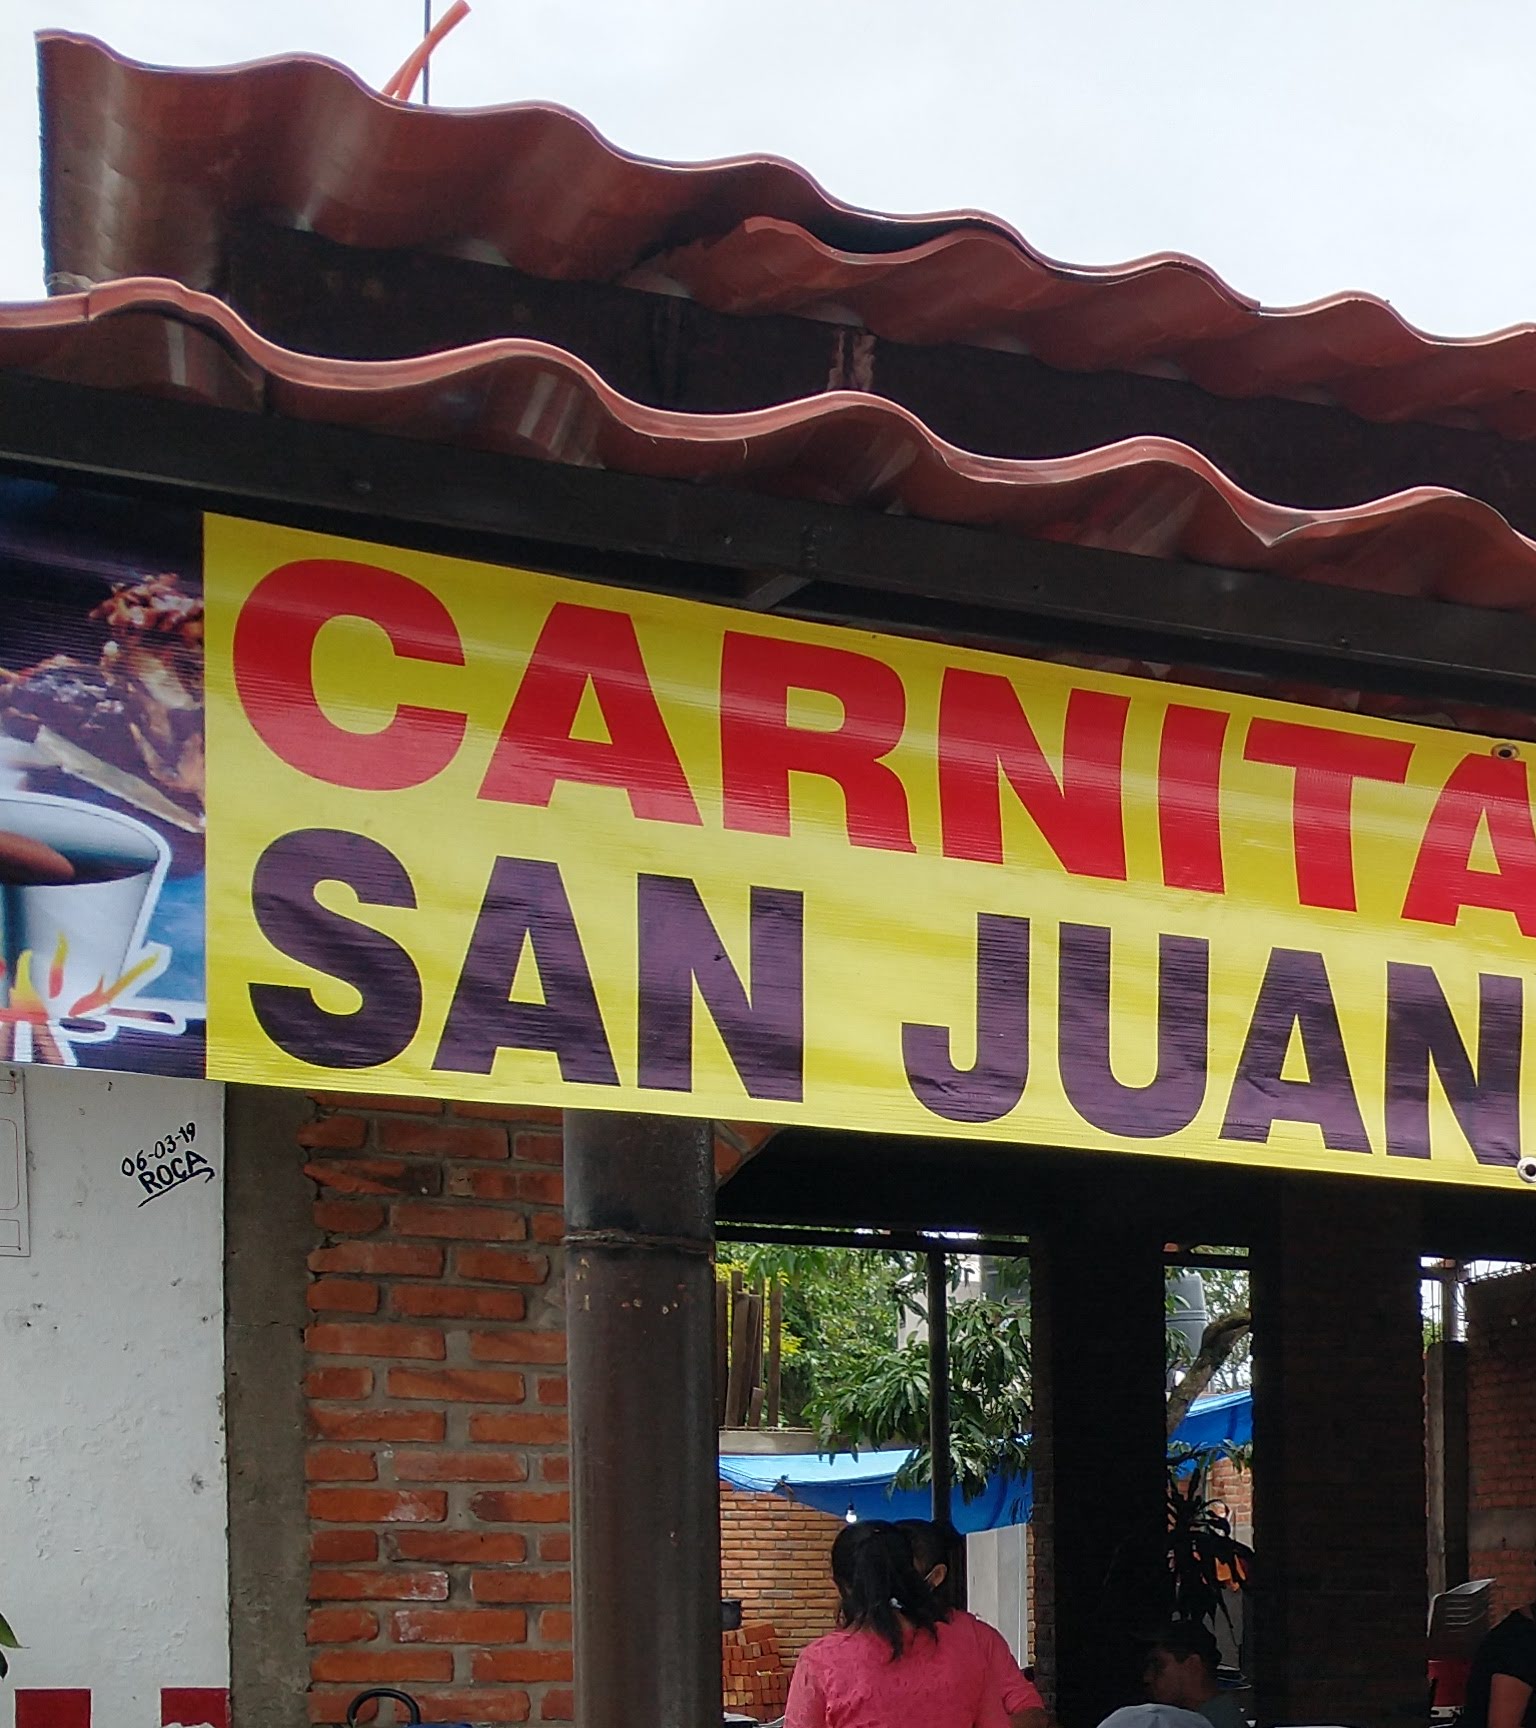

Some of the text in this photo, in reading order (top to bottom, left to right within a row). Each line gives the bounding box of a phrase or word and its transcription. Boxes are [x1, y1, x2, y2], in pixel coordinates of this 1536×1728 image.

[248, 828, 804, 1103] SAN
[901, 912, 1523, 1168] JUAN
[121, 1122, 196, 1177] 06-03-19
[137, 1150, 208, 1195] ROCA
